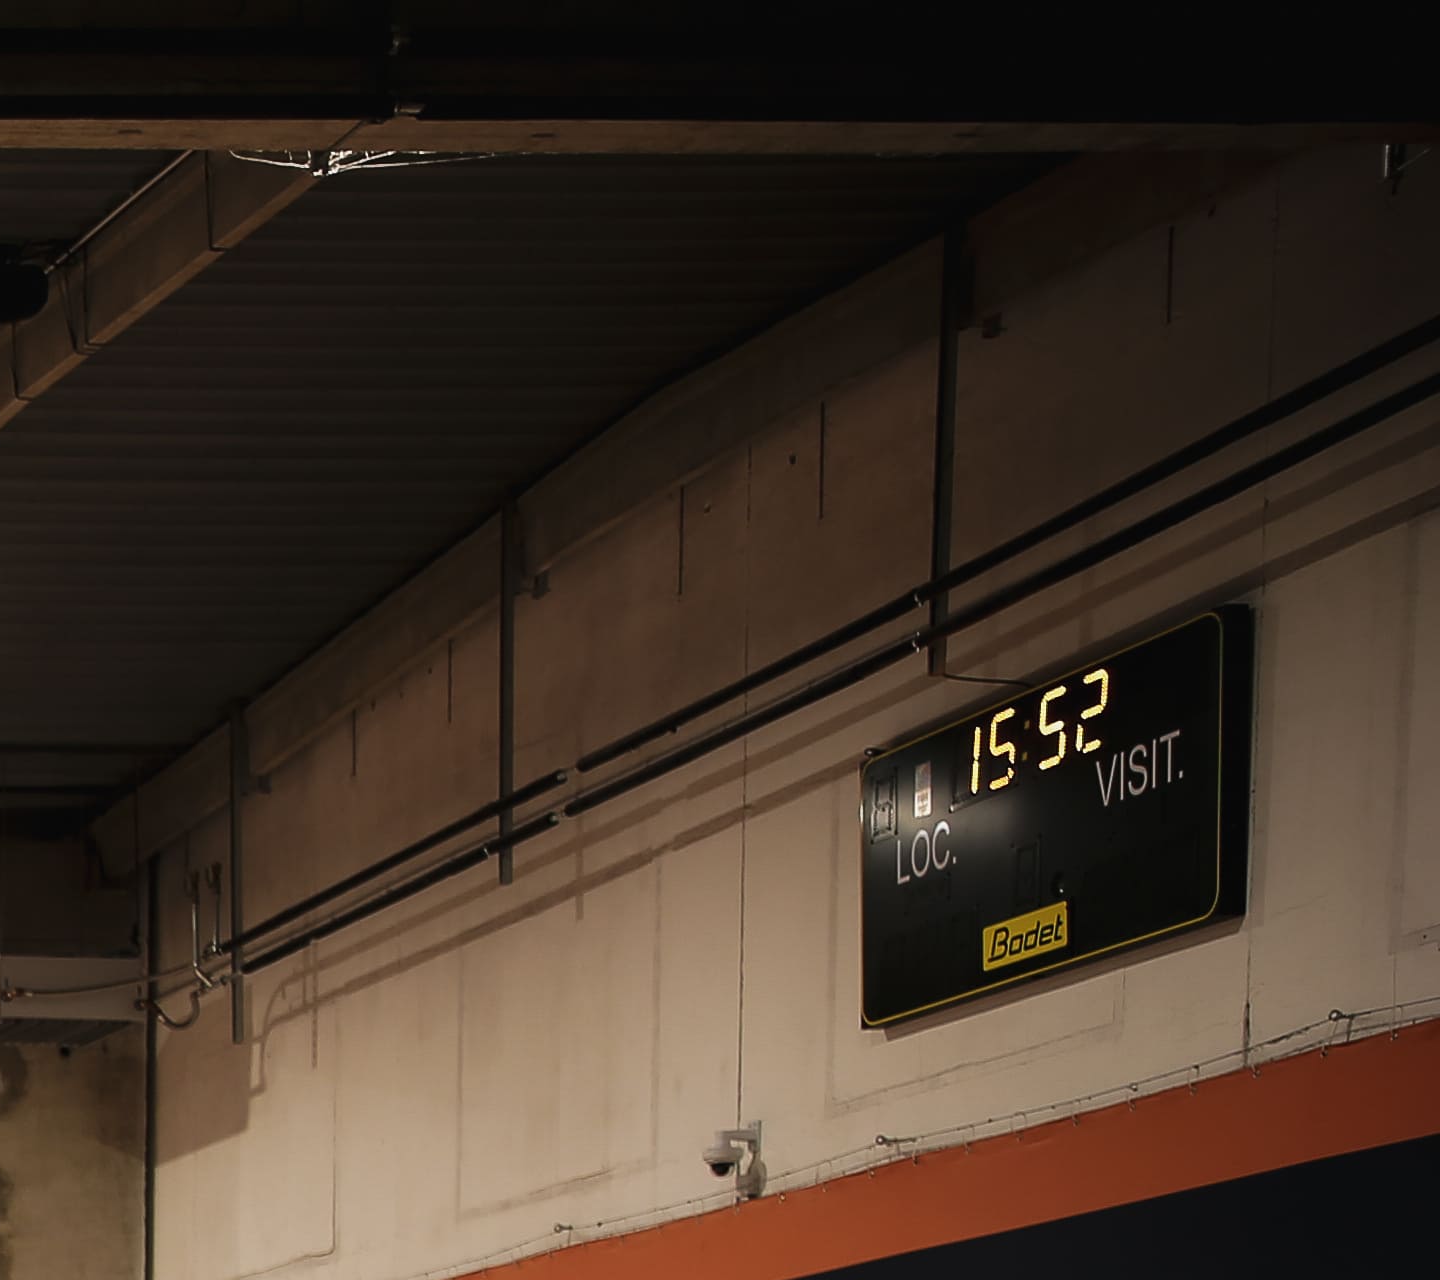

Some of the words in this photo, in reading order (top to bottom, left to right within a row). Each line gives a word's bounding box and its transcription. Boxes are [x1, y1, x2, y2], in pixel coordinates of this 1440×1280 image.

[1095, 729, 1184, 807] VISIT.
[895, 820, 957, 885] LOC.
[988, 915, 1065, 961] Bodet
